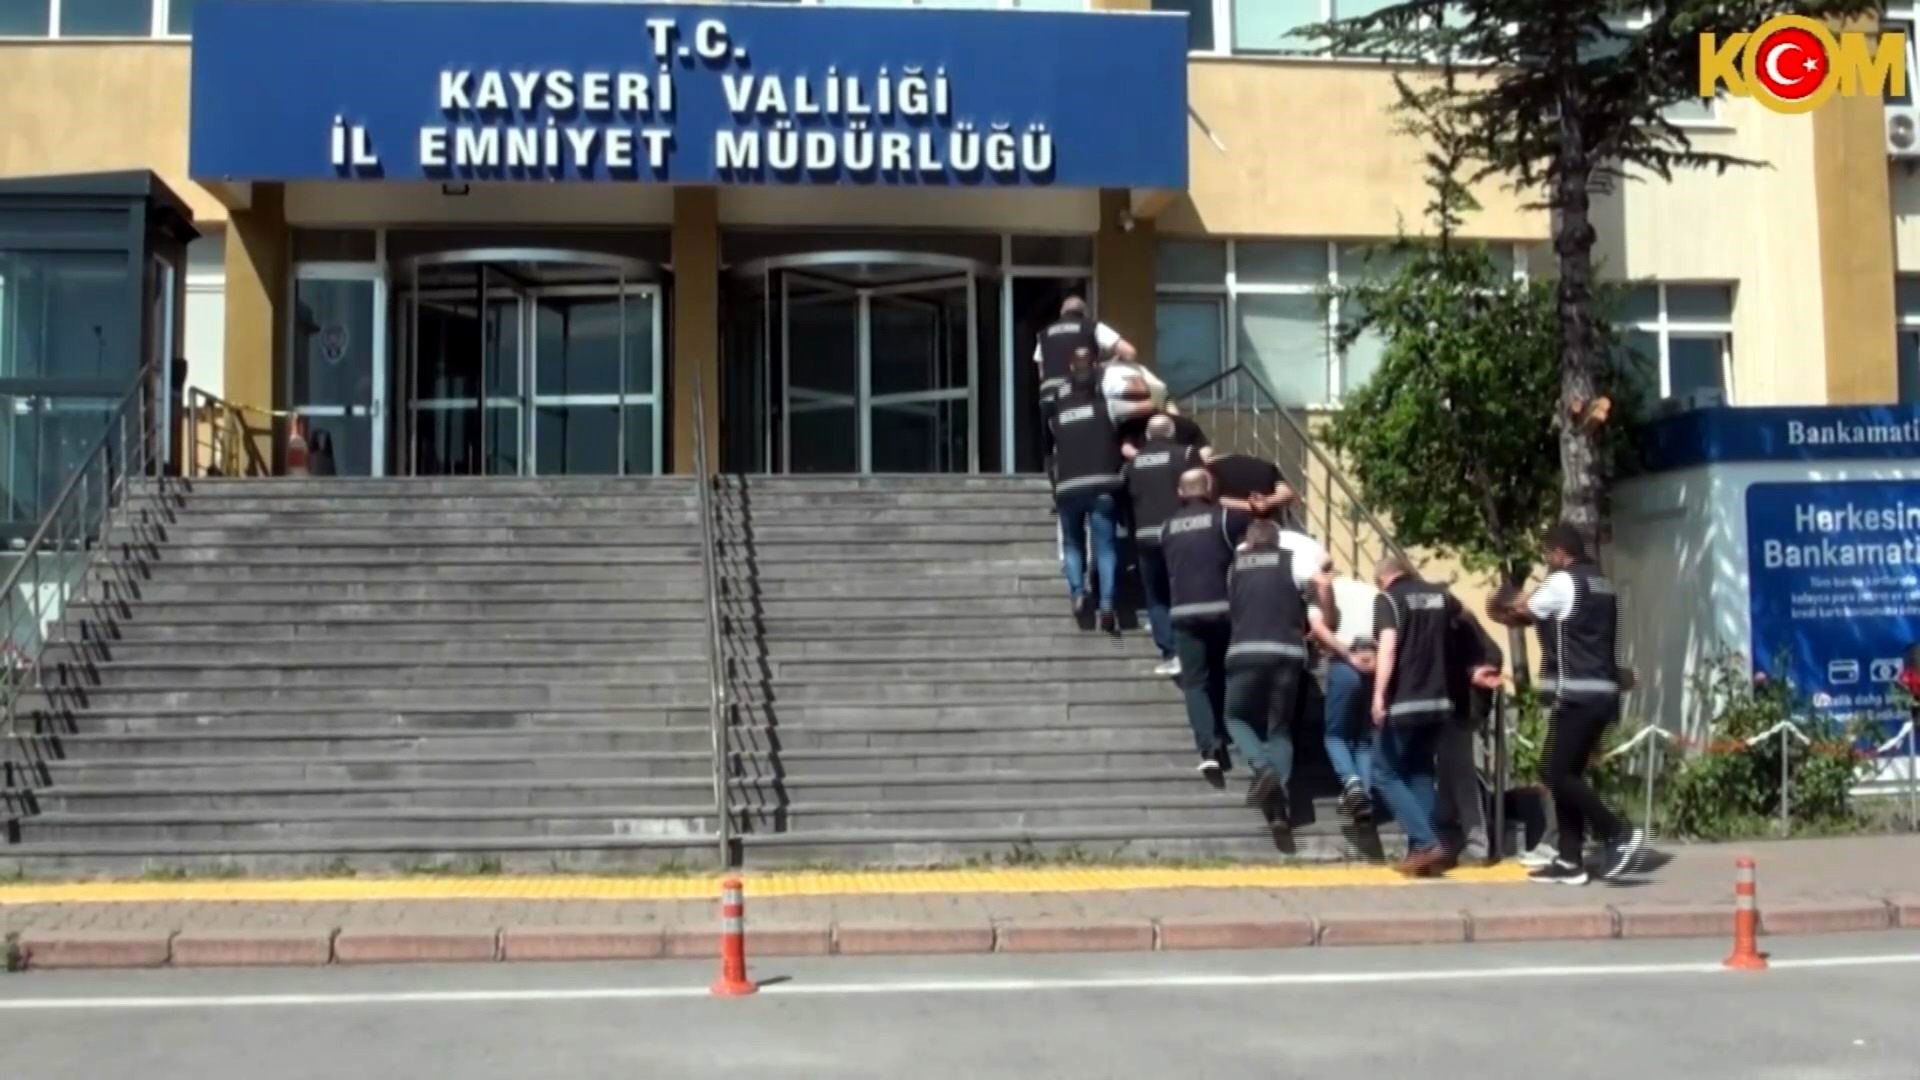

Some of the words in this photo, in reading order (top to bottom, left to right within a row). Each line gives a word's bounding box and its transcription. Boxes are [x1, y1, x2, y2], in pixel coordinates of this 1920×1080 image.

[646, 18, 747, 58] T.C.
[440, 64, 672, 112] KAYSERİ
[722, 65, 948, 115] VALİLİĞİ
[331, 114, 378, 166] İL
[419, 117, 673, 167] EMNİYET
[715, 120, 1053, 172] MÜDÜRLÜĞÜ
